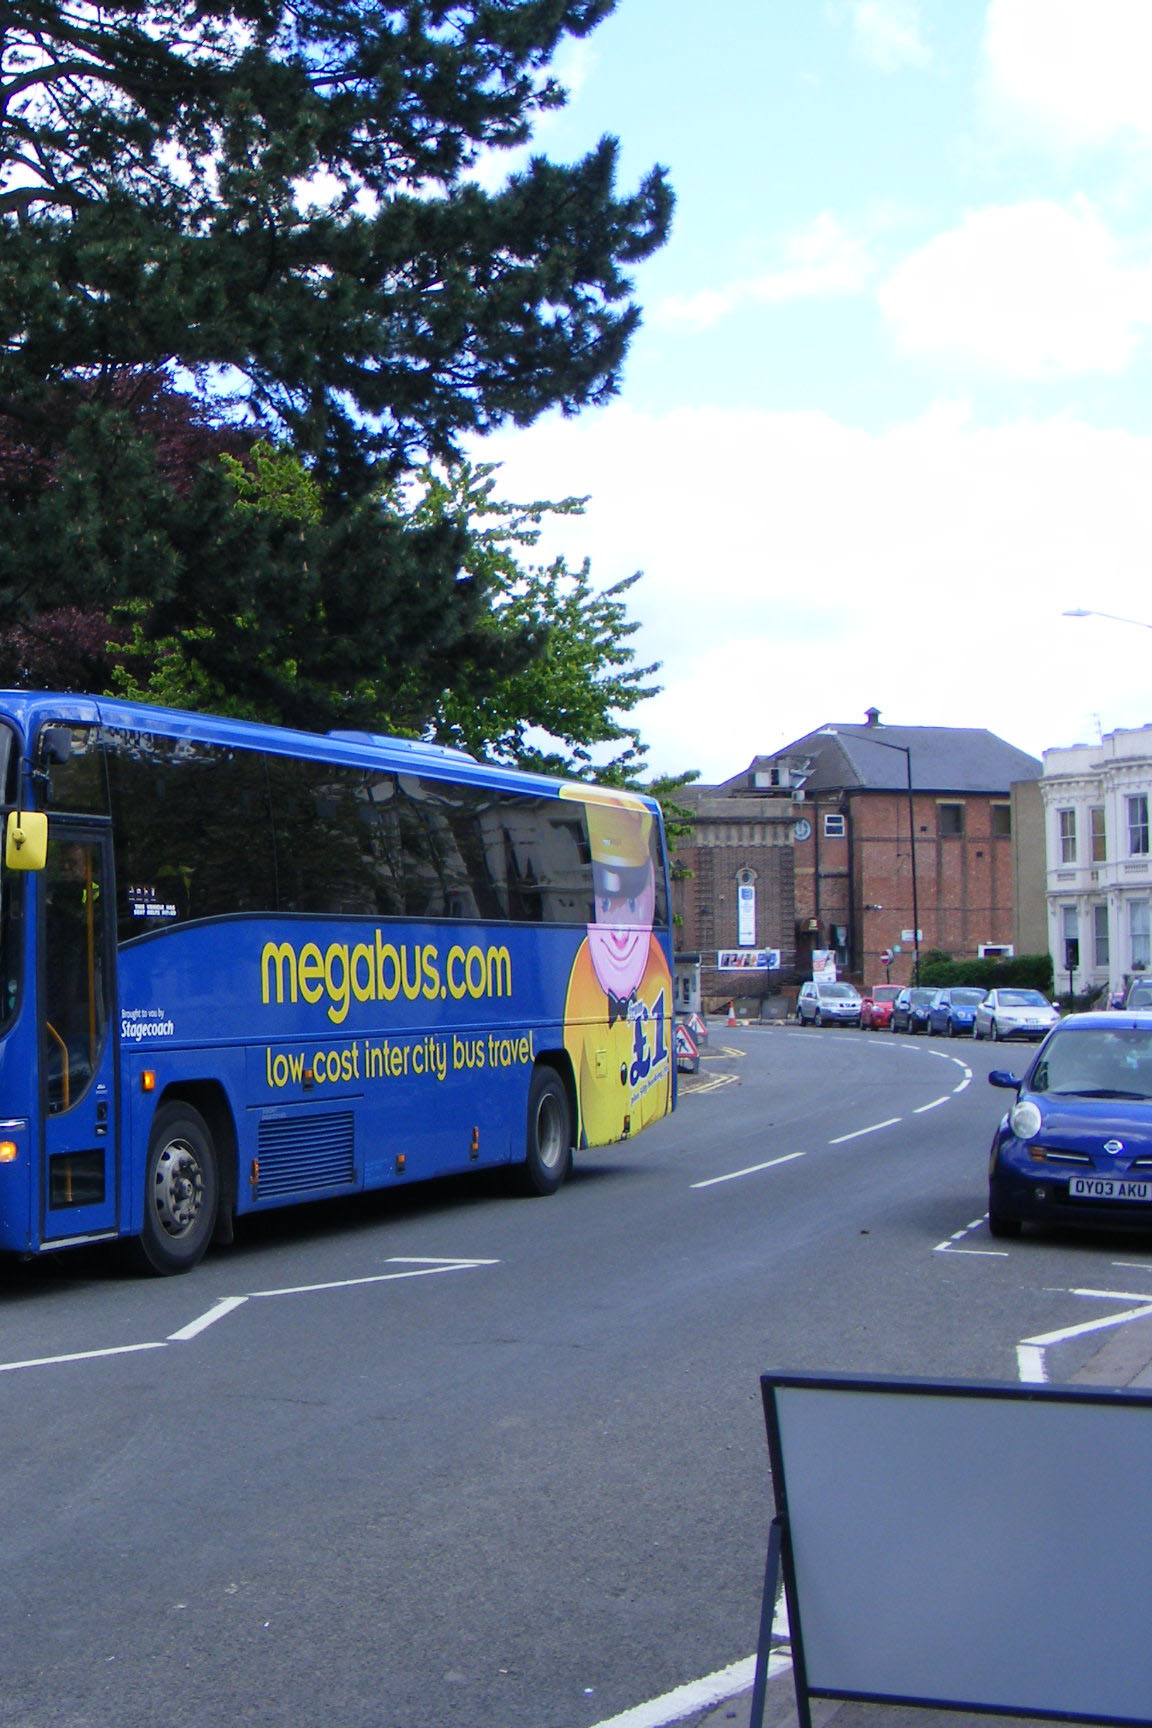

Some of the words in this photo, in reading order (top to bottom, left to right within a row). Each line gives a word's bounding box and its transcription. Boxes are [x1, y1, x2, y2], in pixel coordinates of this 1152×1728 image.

[261, 928, 512, 1025] megabus.com
[120, 1020, 174, 1042] Stagecoach
[121, 1008, 141, 1021] Brought
[157, 1007, 165, 1020] by
[629, 987, 668, 1087] £1
[266, 1047, 305, 1088] low
[312, 1041, 360, 1084] cost
[453, 1034, 485, 1070] bus
[488, 1030, 536, 1068] travel
[1075, 1180, 1114, 1196] OY03
[1118, 1182, 1148, 1198] AKU
